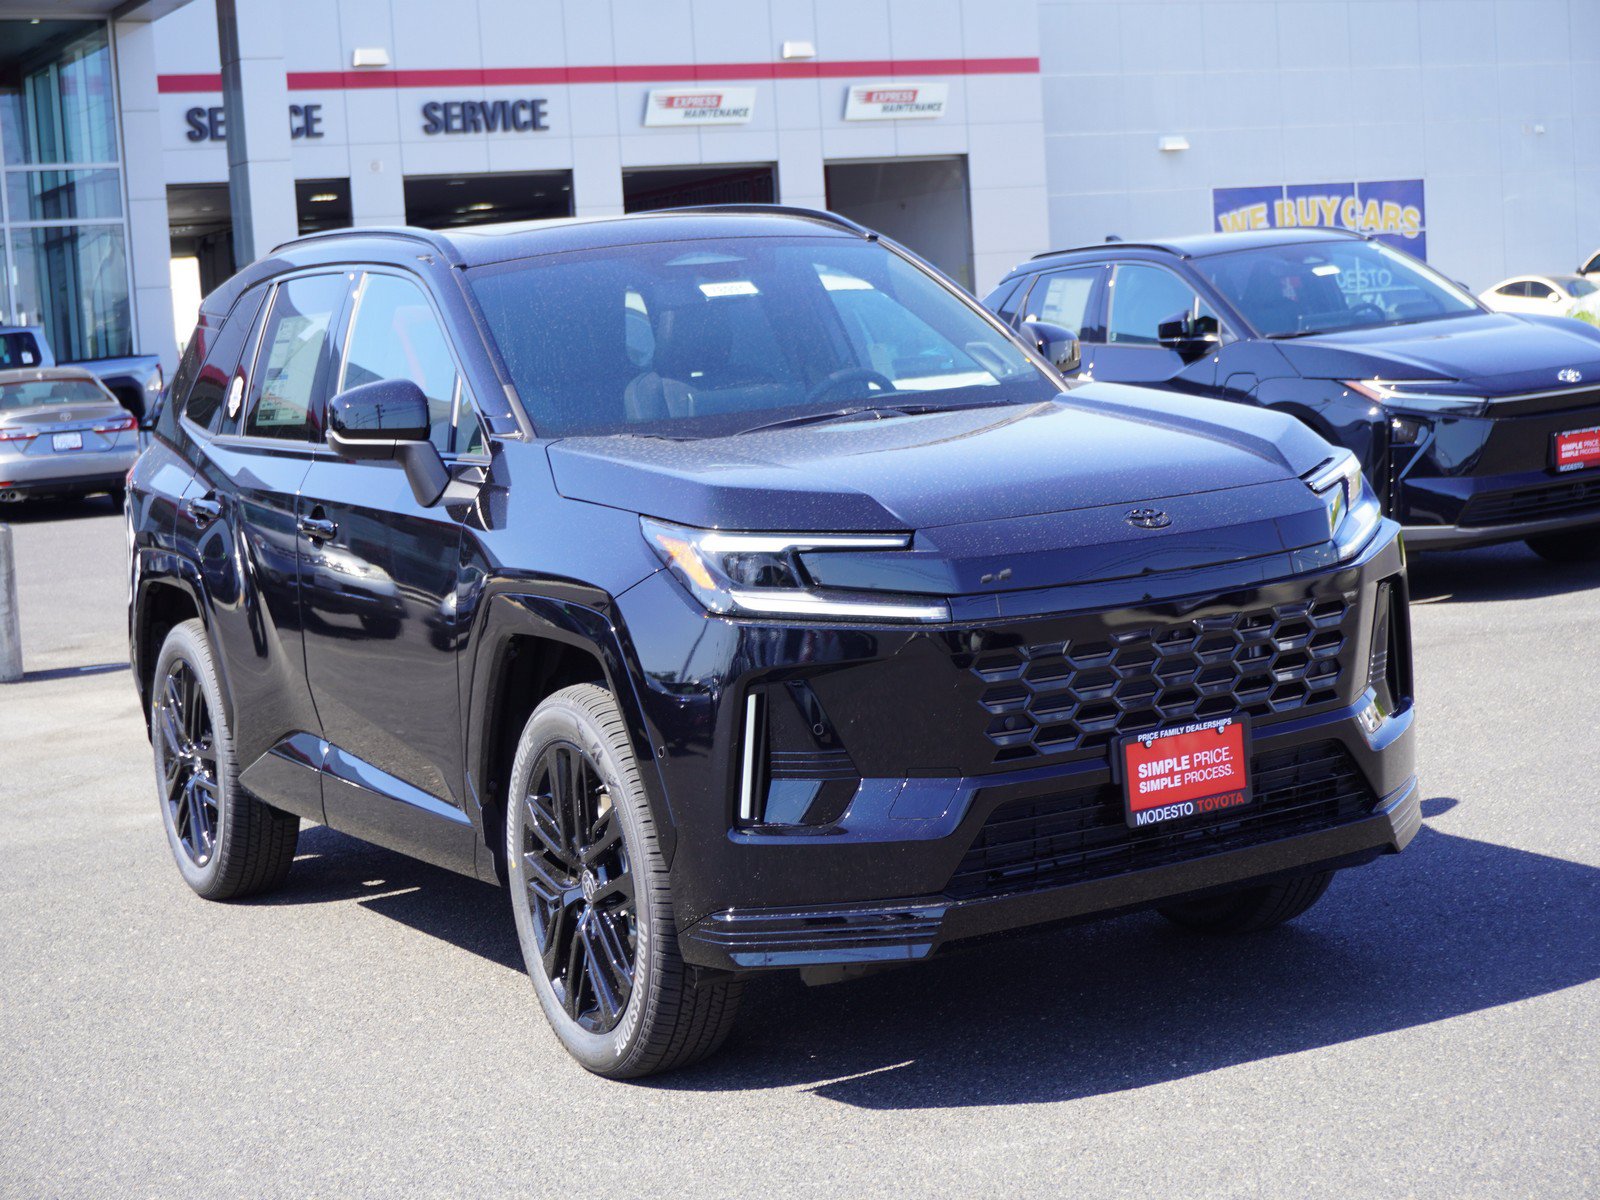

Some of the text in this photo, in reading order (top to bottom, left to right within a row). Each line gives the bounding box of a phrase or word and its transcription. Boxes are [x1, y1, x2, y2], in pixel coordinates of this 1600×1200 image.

[672, 96, 718, 107] EXPRESS
[871, 91, 914, 103] EXPRESS
[881, 103, 943, 113] MAINTENANCE
[186, 104, 323, 142] SECE
[423, 99, 549, 135] SERVICE
[683, 108, 750, 119] MAINTENANCE
[1218, 195, 1421, 239] WE BUY CARS
[1137, 717, 1232, 743] PRICE FAMILY DEALERSHIPS
[1138, 746, 1233, 779] SIMPLE PRICE.
[1139, 763, 1235, 794] SIMPLE PROCESS.
[1136, 791, 1245, 826] MODESTO TOYOTA
[613, 920, 648, 1057] BRIDGESTONE
